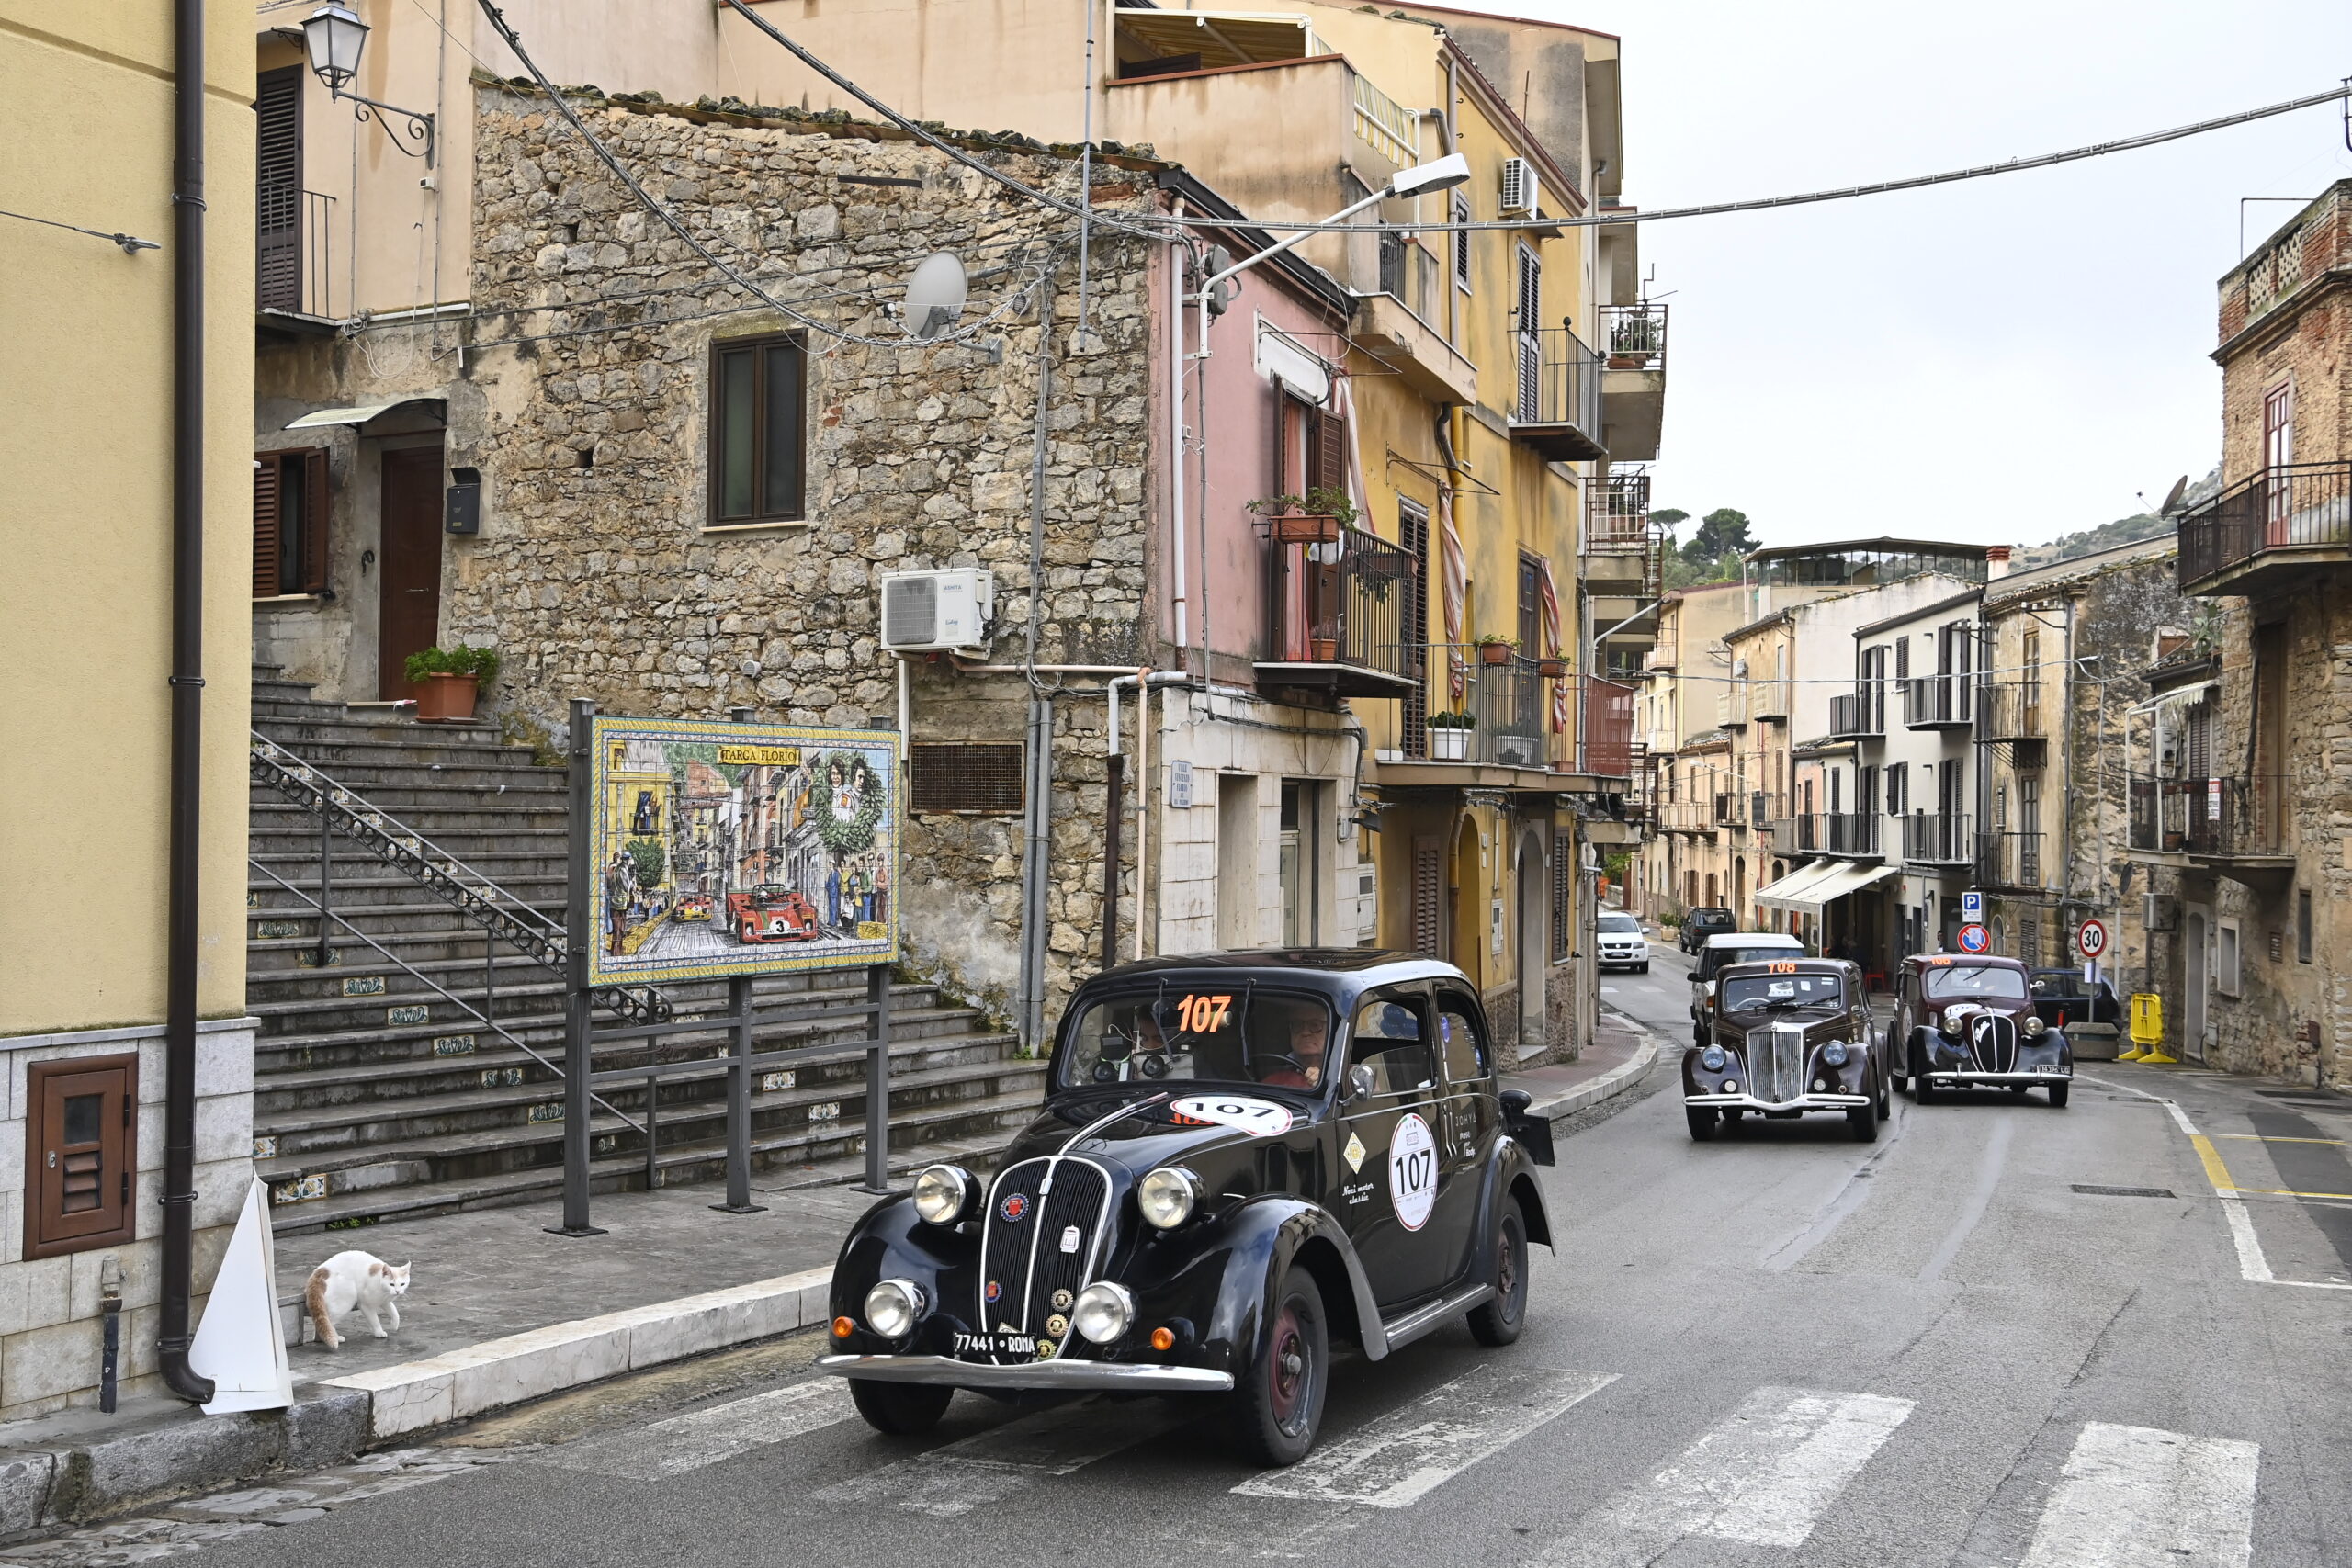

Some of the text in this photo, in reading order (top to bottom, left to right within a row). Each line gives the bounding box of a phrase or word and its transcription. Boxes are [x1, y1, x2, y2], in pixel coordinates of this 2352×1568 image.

[724, 750, 796, 761] TARGA FLORIO
[1176, 783, 1188, 792] FLORIO
[1966, 896, 1976, 908] P
[775, 920, 785, 933] 3
[2084, 930, 2100, 948] 30
[1768, 962, 1796, 975] 108
[1177, 994, 1232, 1032] 107
[1189, 1102, 1275, 1118] 107
[1396, 1149, 1430, 1195] 107
[1349, 1191, 1369, 1204] classic
[955, 1334, 1035, 1352] 77441 ROMA
